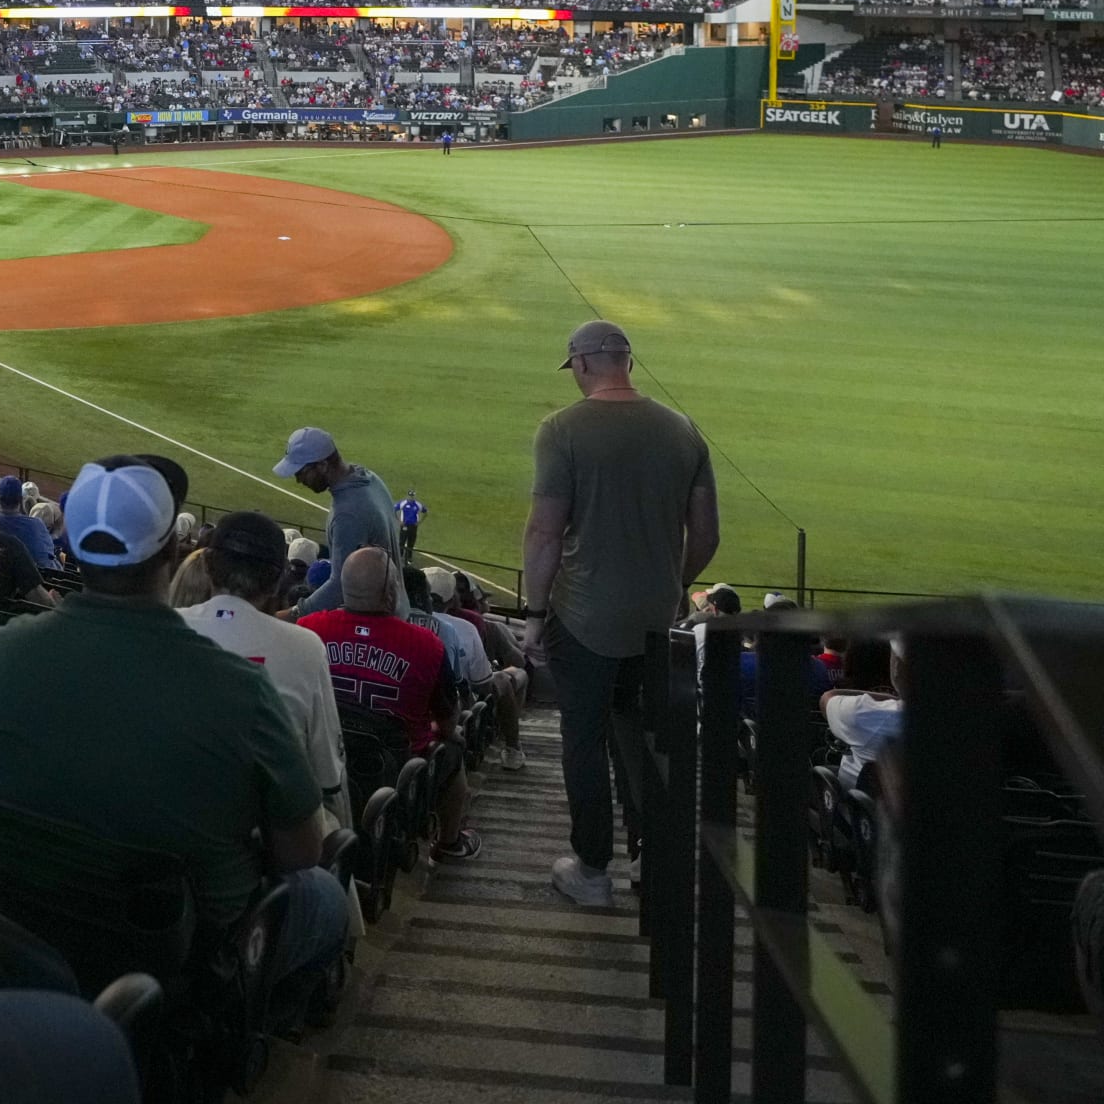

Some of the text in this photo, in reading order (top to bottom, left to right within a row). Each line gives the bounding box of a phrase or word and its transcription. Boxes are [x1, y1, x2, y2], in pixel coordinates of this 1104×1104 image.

[859, 7, 889, 15] SHIFT
[940, 8, 972, 17] SHIFT
[242, 109, 298, 121] Germania
[410, 112, 460, 121] VICTORY
[766, 108, 840, 125] SEATGEEK
[1004, 113, 1050, 131] UTA
